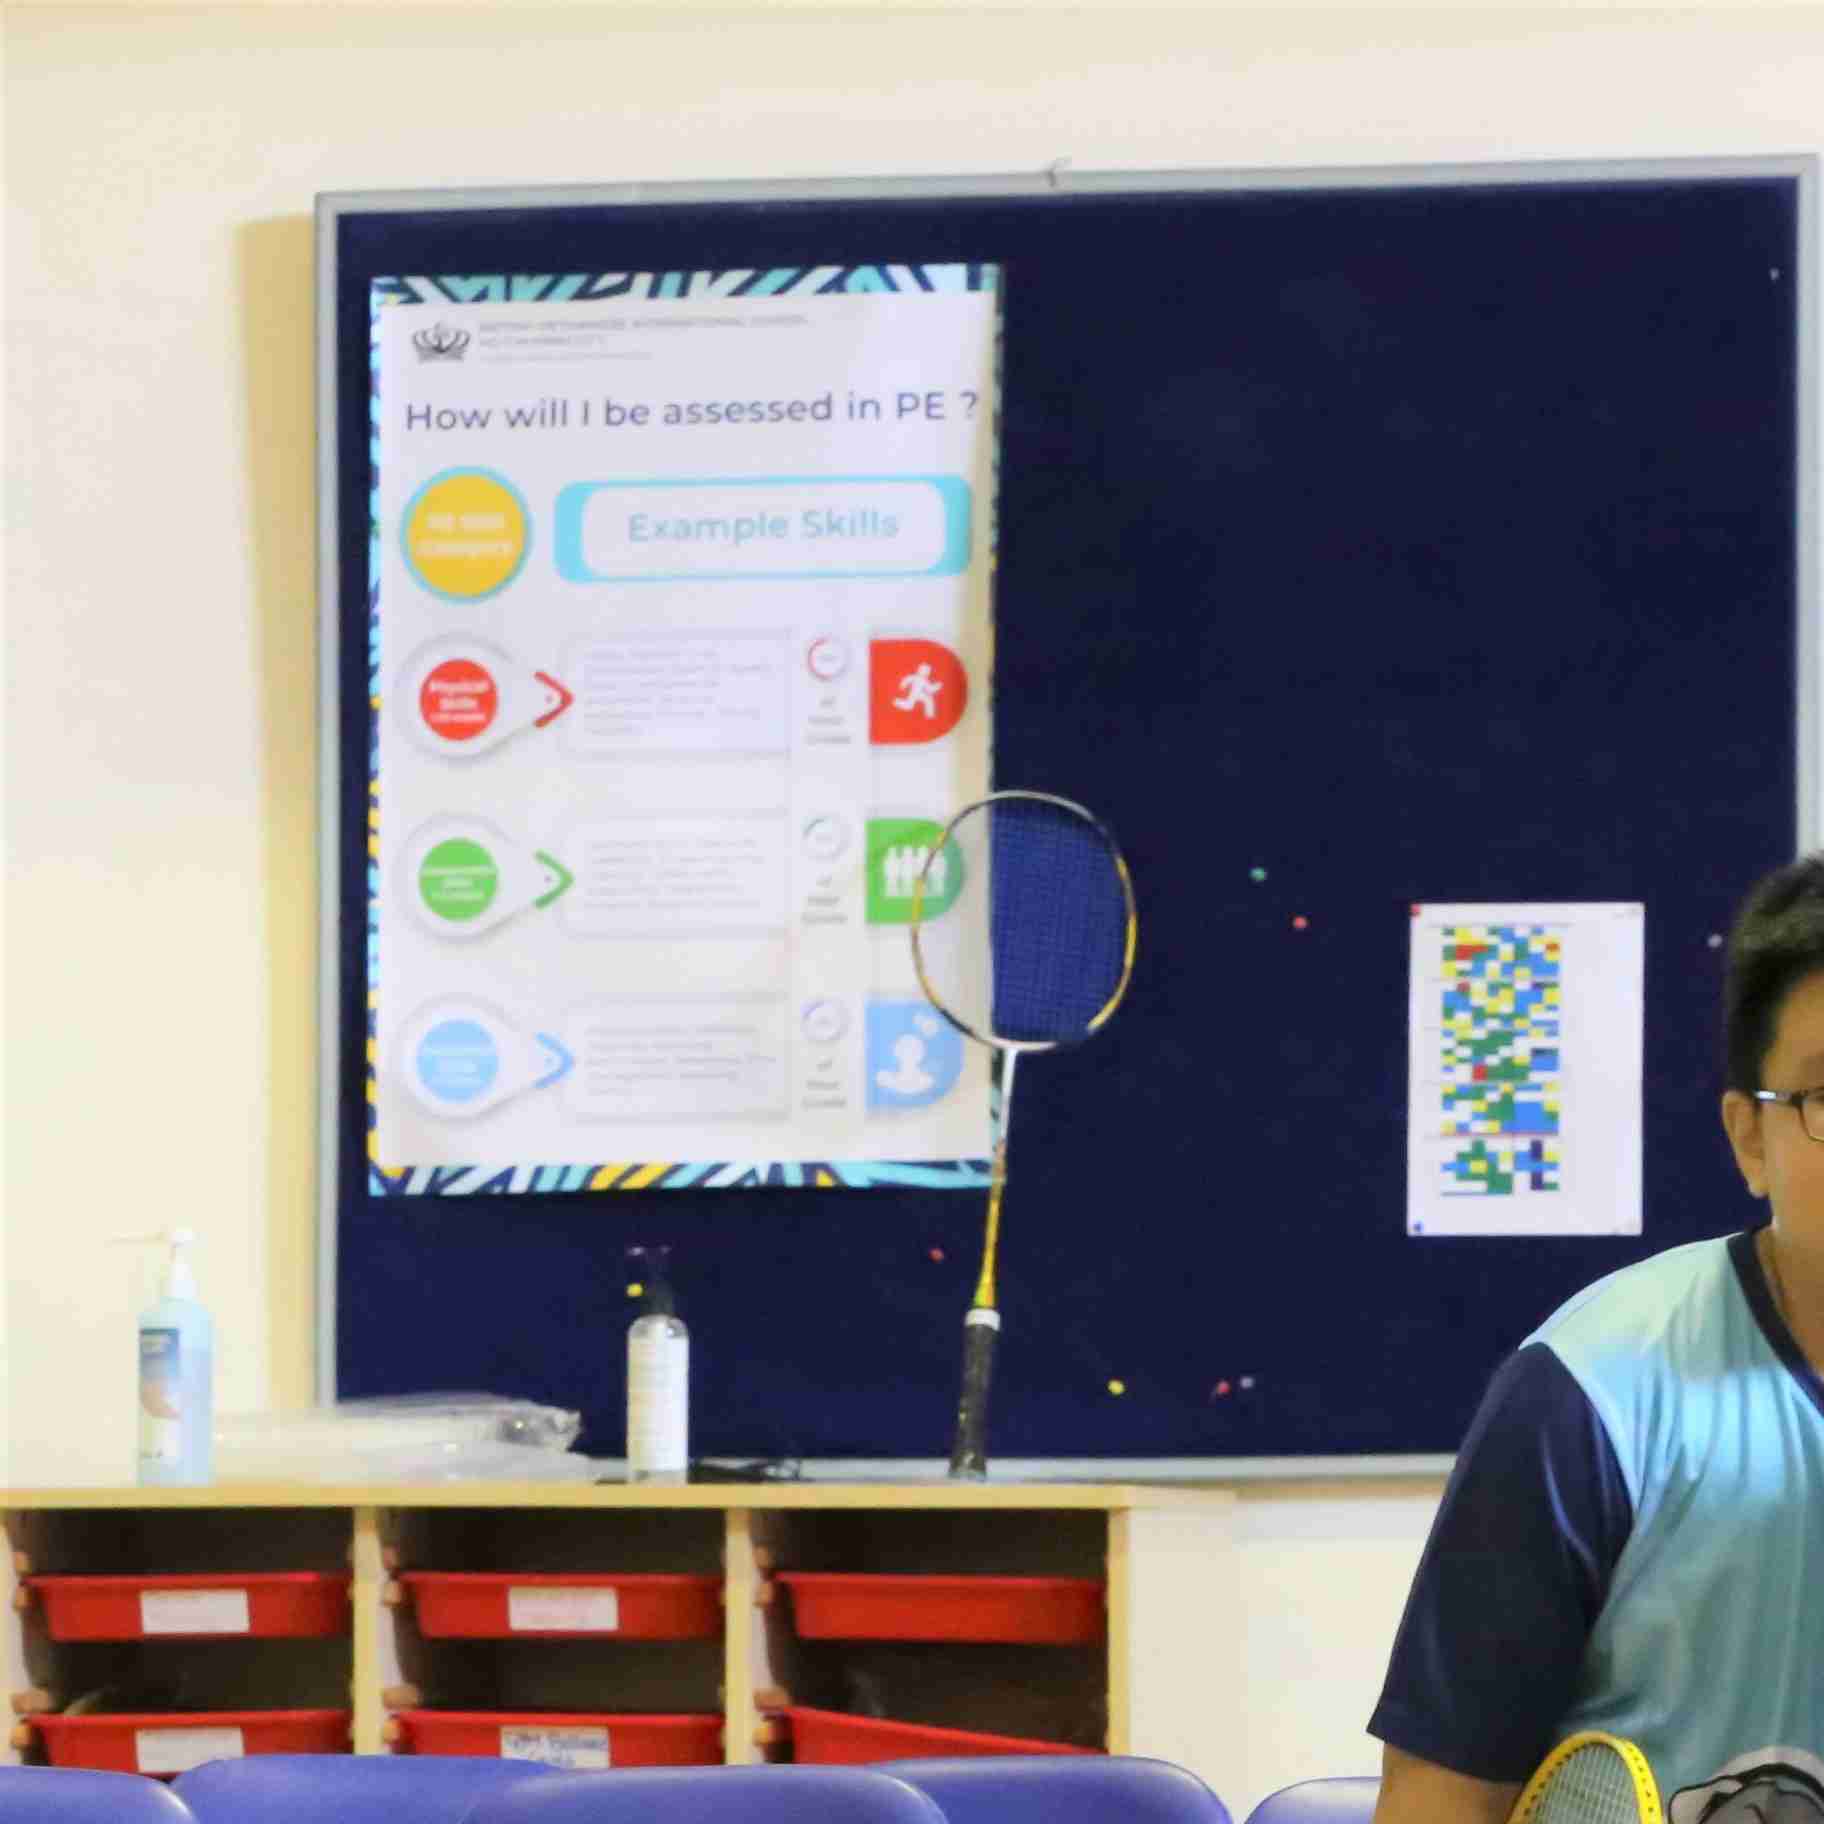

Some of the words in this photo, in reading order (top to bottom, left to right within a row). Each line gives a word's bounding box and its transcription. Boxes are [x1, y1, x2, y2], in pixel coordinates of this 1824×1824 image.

[405, 403, 491, 430] How
[504, 398, 568, 428] will
[581, 400, 591, 426] I
[603, 396, 650, 427] be
[663, 392, 833, 424] assessed
[848, 391, 881, 421] in
[896, 391, 946, 420] PE
[627, 509, 788, 547] Example
[800, 507, 900, 539] Skills
